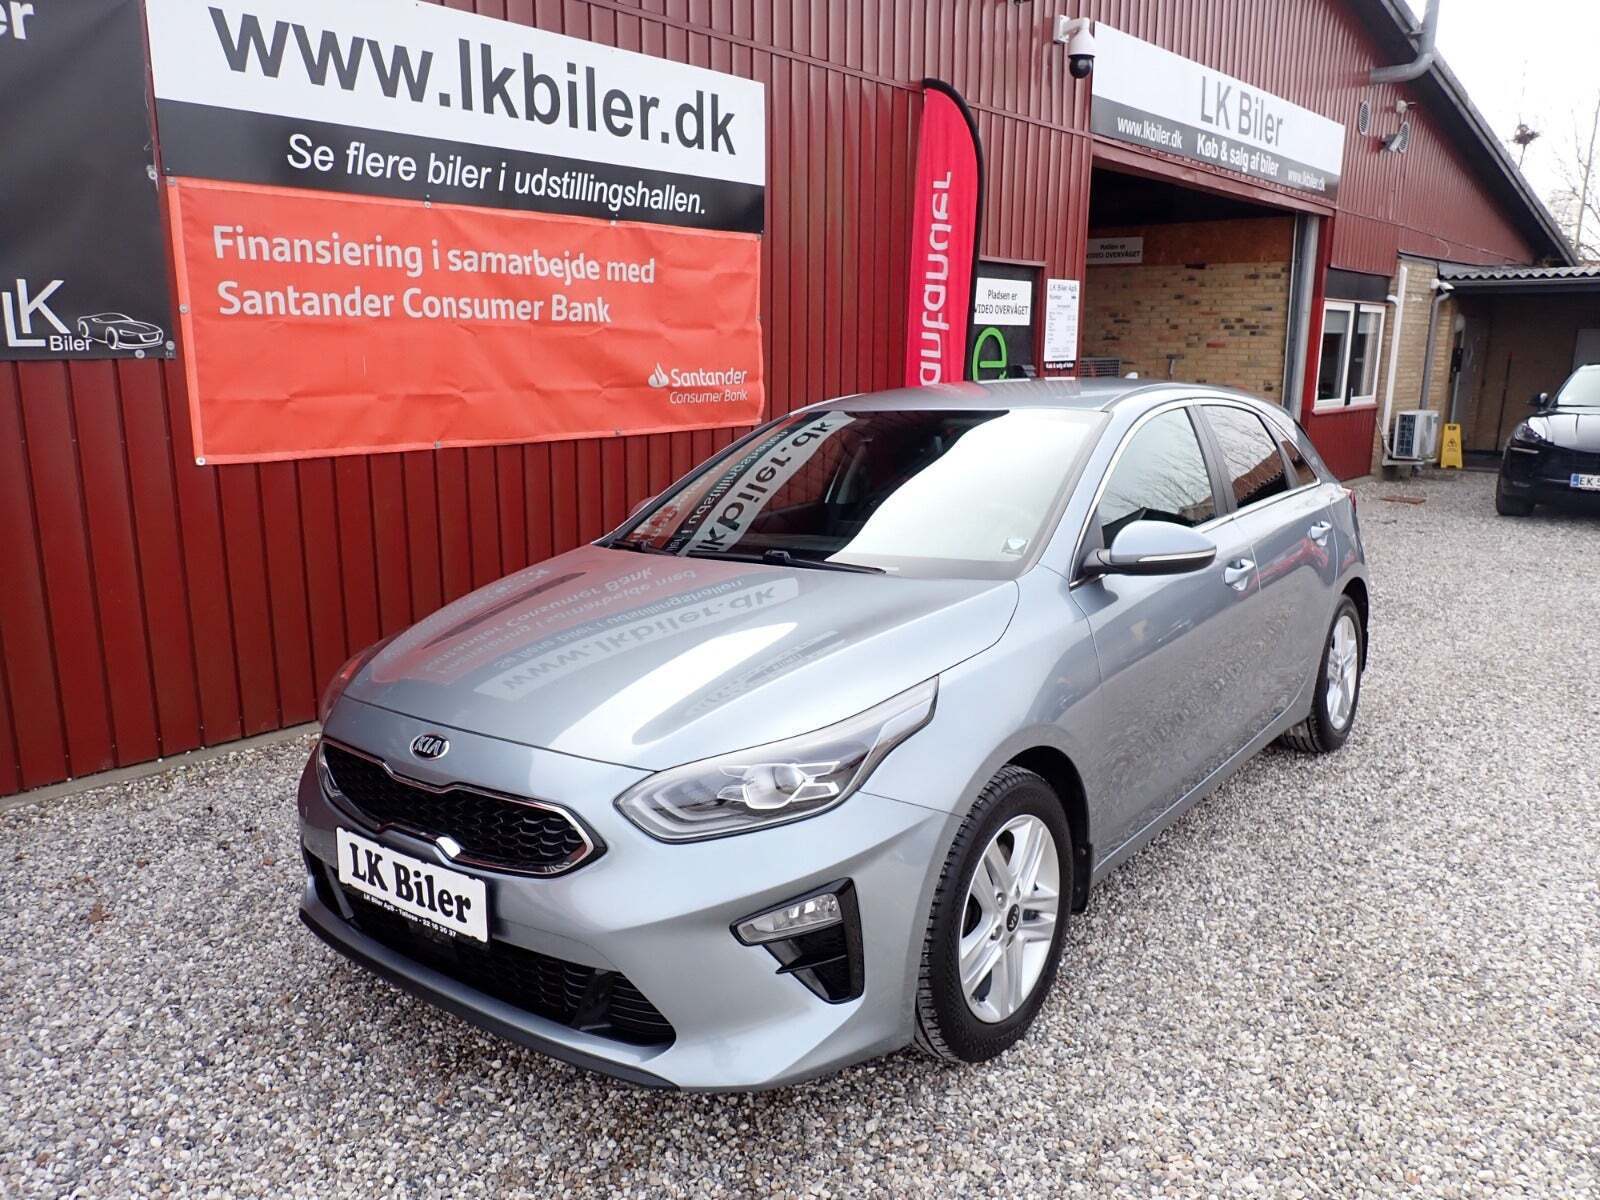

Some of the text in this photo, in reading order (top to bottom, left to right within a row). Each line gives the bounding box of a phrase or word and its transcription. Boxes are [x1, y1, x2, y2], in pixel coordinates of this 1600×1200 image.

[208, 6, 736, 156] www.lkbiler.dk
[1117, 115, 1183, 149] www.lkbiler.dk
[1200, 76, 1283, 147] LK Biler
[287, 133, 706, 215] Se flere biler i udstillingshallen.
[1196, 133, 1279, 177] Køb & salg af biler
[213, 225, 656, 286] Finansiering i samarbejde med
[1, 278, 92, 352] LK Biler
[217, 280, 612, 323] Santander Consumer Bank
[988, 289, 1010, 300] Pladsen
[669, 389, 748, 405] Consumer Bank
[670, 367, 748, 388] Santander
[413, 736, 443, 756] KIA
[350, 842, 472, 924] LK Biler
